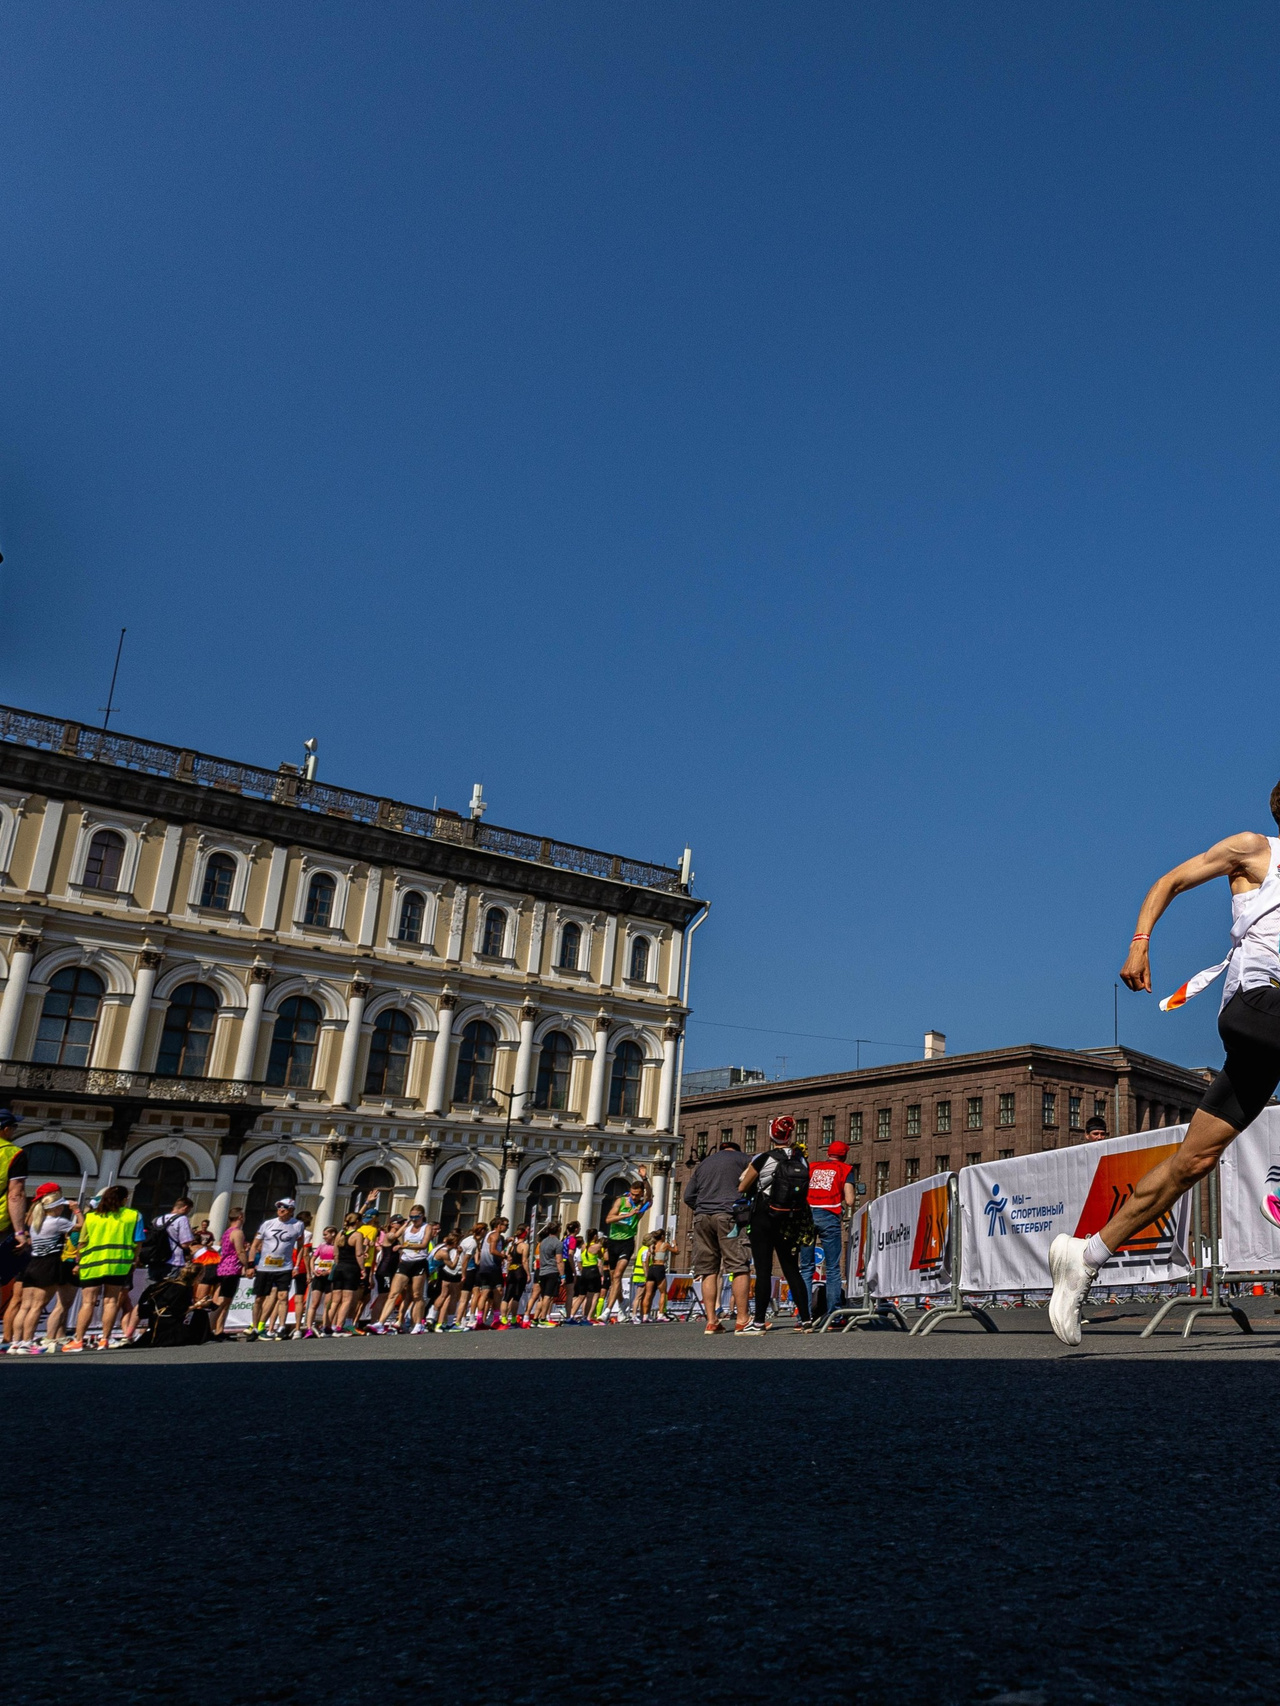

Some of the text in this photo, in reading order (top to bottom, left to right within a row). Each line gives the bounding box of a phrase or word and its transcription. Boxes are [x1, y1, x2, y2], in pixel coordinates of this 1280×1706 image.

[1012, 1194, 1024, 1205] МЫ
[1011, 1201, 1064, 1219] СПОРТИВНЫЙ
[1011, 1220, 1052, 1234] ПЕТЕРБУРГ
